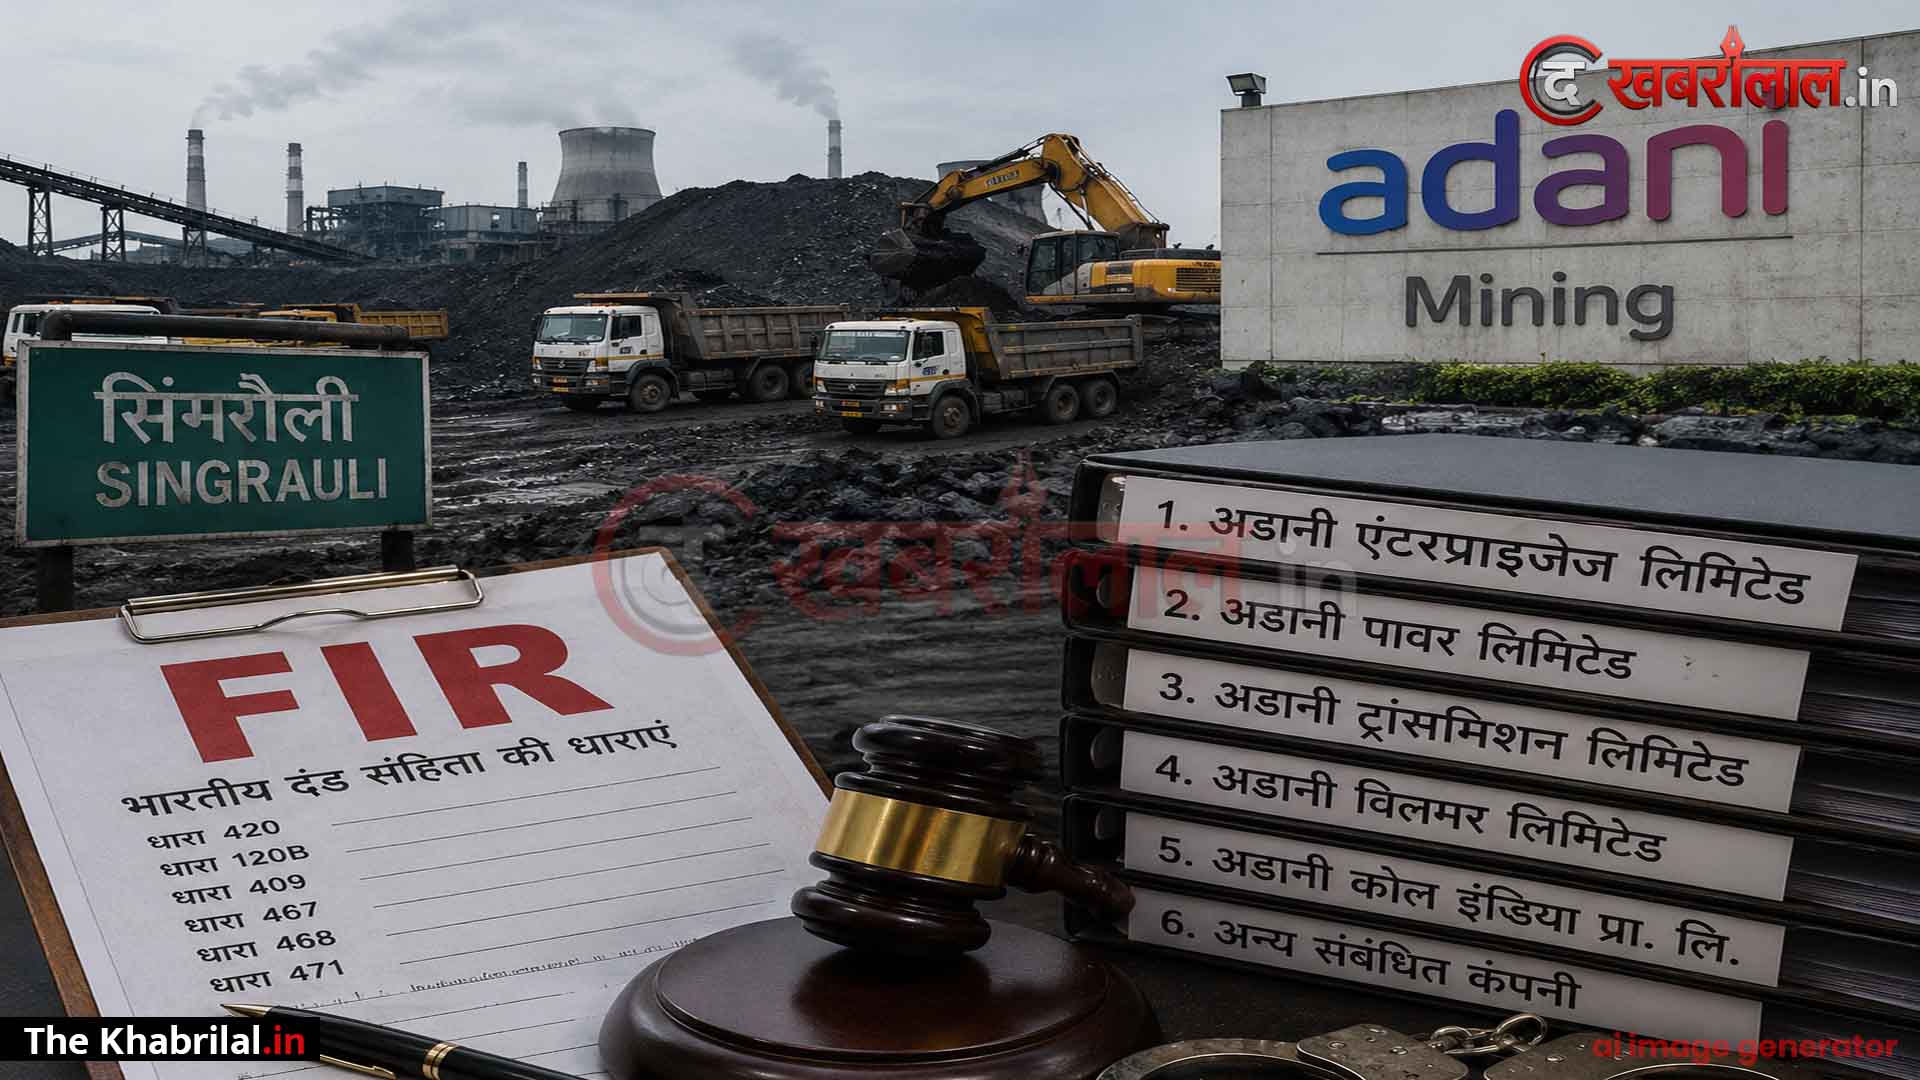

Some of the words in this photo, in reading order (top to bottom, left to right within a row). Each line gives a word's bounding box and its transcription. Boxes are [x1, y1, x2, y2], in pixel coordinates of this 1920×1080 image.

[1319, 109, 1789, 235] adani
[1405, 272, 1676, 341] Mining
[96, 457, 387, 507] SINGRAULI
[1157, 500, 1188, 531] 1.
[1208, 507, 1339, 549] अडानी
[1355, 515, 1619, 583] एंटरप्राइजेज
[1639, 545, 1812, 605] लिमिटेड
[1164, 588, 1200, 621] 2.
[1219, 598, 1347, 641] अडानी
[1362, 616, 1461, 657] पावर
[1477, 622, 1638, 680] लिमिटेड
[160, 624, 614, 763] FIR
[1159, 672, 1195, 704] 3.
[1214, 682, 1342, 726] अडानी
[1356, 697, 1569, 761] ट्रांसमिशन
[1586, 727, 1750, 787] लिमिटेड
[120, 777, 273, 817] भारतीय
[283, 768, 350, 798] दंड
[359, 751, 486, 786] संहिता
[495, 736, 556, 767] की
[567, 719, 678, 756] धाराएं
[1155, 754, 1193, 786] 4.
[1212, 765, 1338, 809] अडानी
[1353, 778, 1490, 834] विलमर
[1506, 802, 1668, 863] लिमिटेड
[146, 830, 206, 849] धारा
[223, 820, 281, 840] 420
[159, 857, 219, 877] धारा
[231, 844, 310, 868] 120B
[171, 884, 233, 905] धारा
[249, 874, 306, 895] 409
[184, 912, 245, 933] धारा
[262, 901, 317, 923] 467
[1158, 835, 1193, 867] 5.
[1212, 847, 1334, 892] अडानी
[1349, 865, 1441, 911] कोल
[1598, 913, 1654, 950] प्रा.
[1675, 918, 1739, 966] लि.
[196, 941, 258, 963] धारा
[276, 930, 337, 952] 468
[209, 971, 272, 993] धारा
[289, 959, 344, 981] 471
[1161, 909, 1195, 939] 6.
[1213, 920, 1298, 958] अन्य
[1312, 933, 1452, 986] संबंधित
[1466, 959, 1583, 1010] कंपनी
